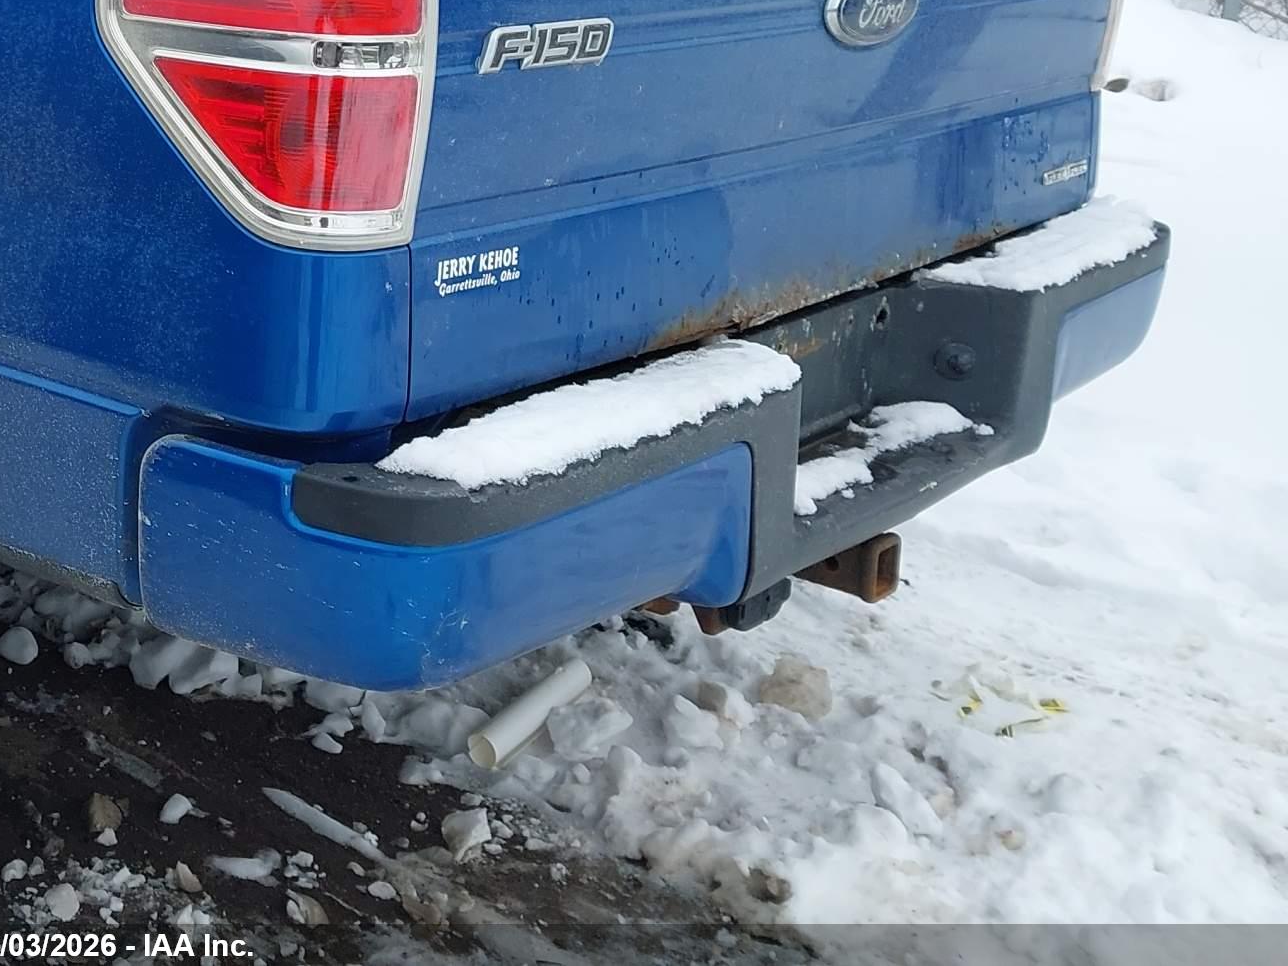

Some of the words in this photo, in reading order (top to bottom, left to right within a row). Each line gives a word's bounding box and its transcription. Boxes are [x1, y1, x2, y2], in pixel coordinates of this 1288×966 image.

[478, 17, 615, 75] F-150
[434, 254, 476, 287] JERRY
[478, 246, 519, 273] KEHOE
[439, 272, 498, 298] Garrettsville,
[499, 267, 521, 283] Ohio
